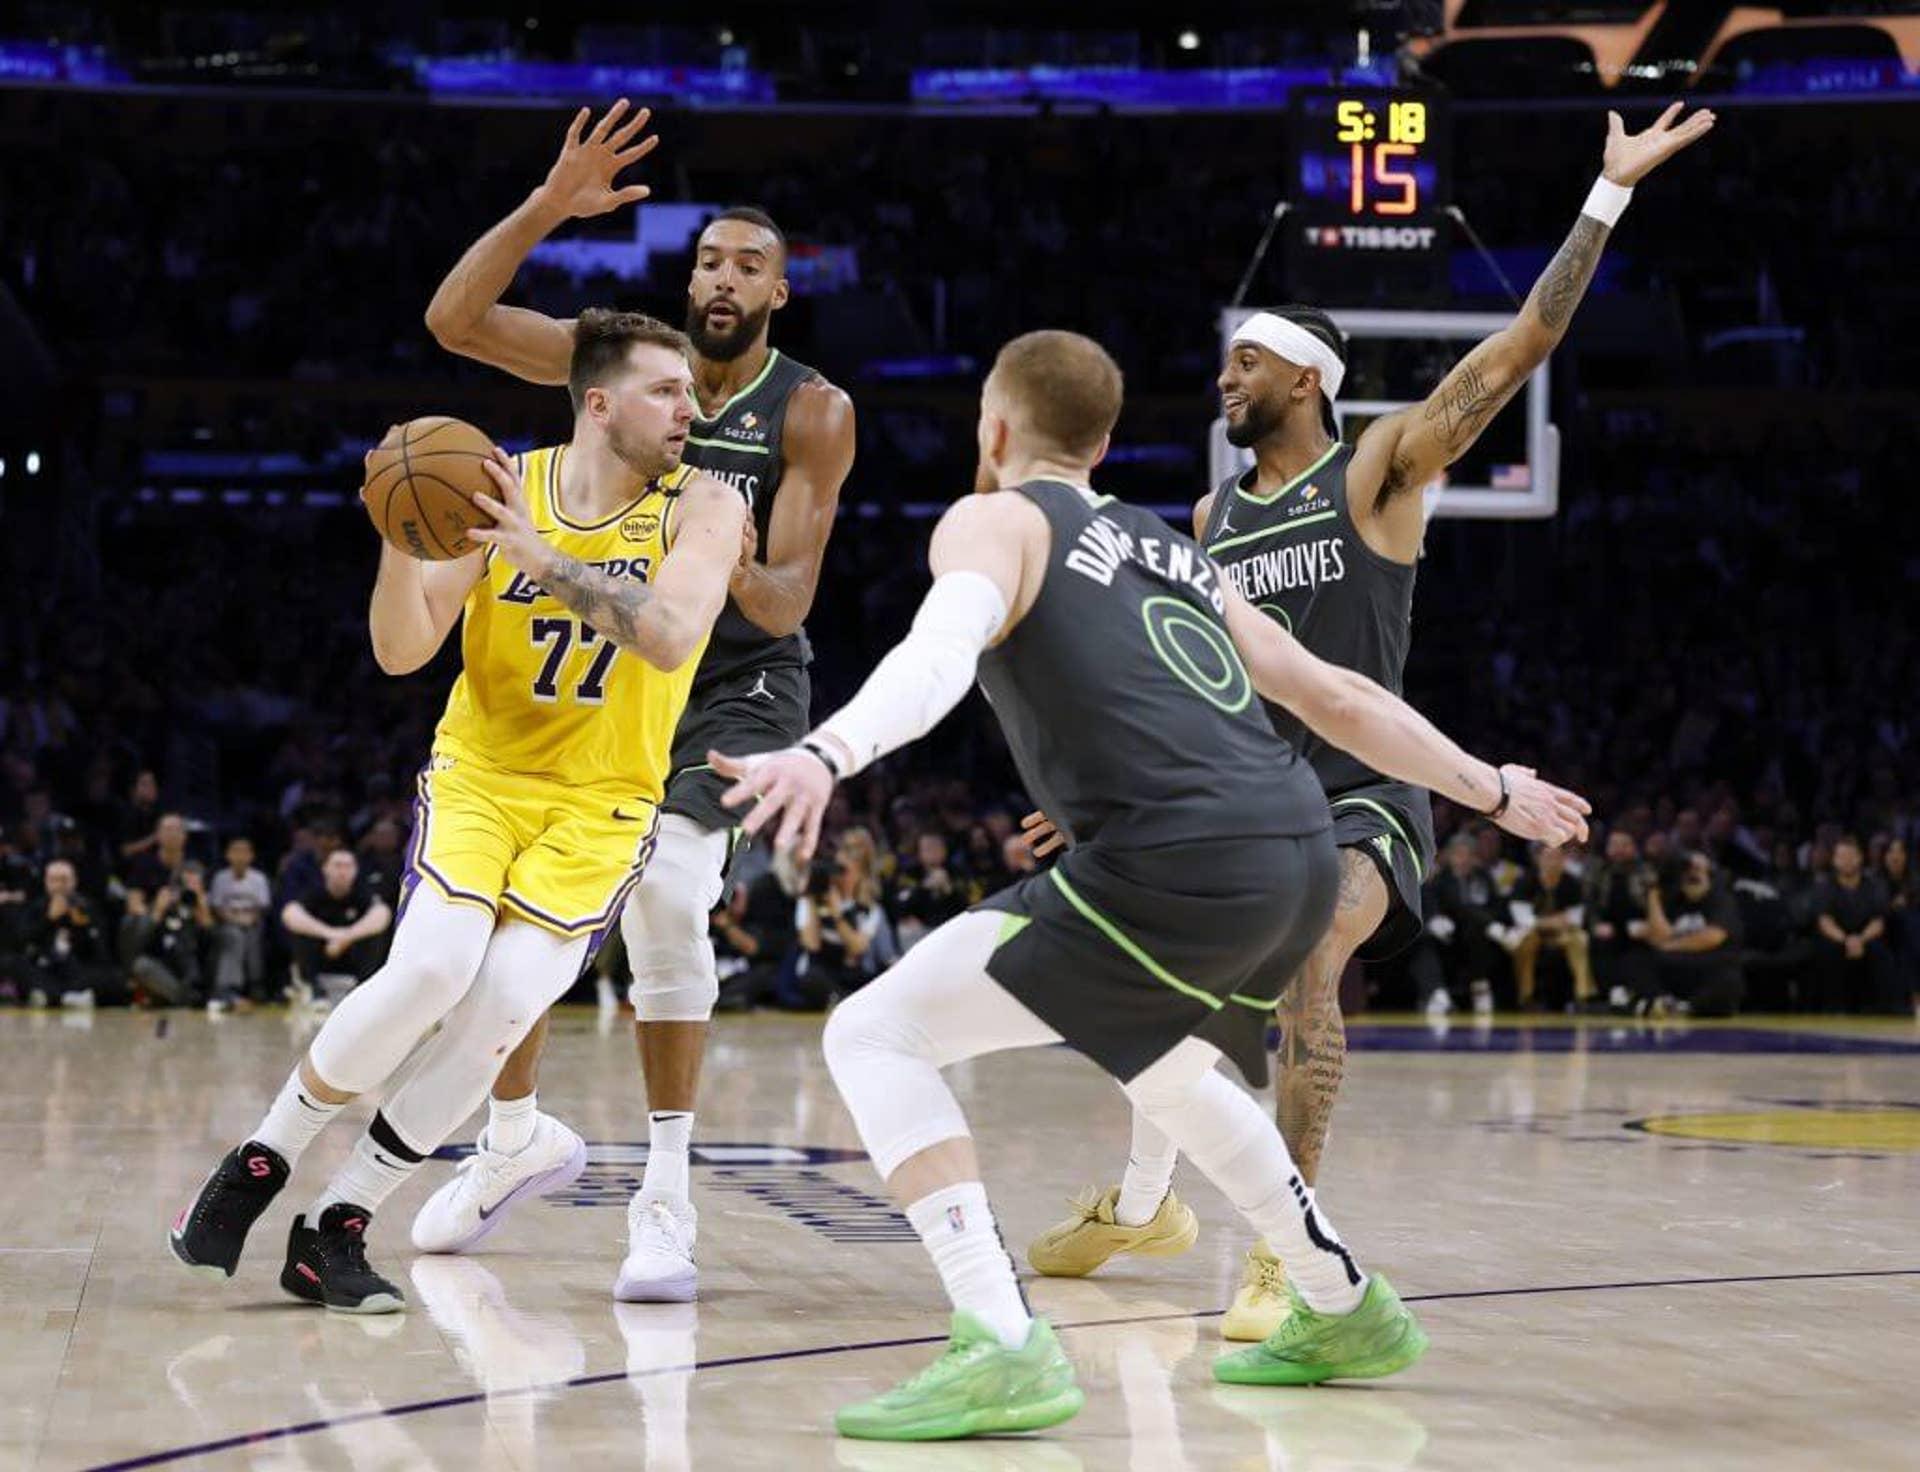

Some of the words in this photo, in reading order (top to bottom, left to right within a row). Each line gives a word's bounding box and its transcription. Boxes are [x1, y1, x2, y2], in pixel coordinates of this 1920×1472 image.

[1337, 100, 1426, 143] 5:18
[1351, 142, 1417, 214] 15
[1341, 227, 1435, 248] TISSOT
[724, 427, 766, 440] sezzle
[1287, 498, 1331, 516] sezzle
[531, 617, 619, 704] 77
[1142, 596, 1250, 713] 0
